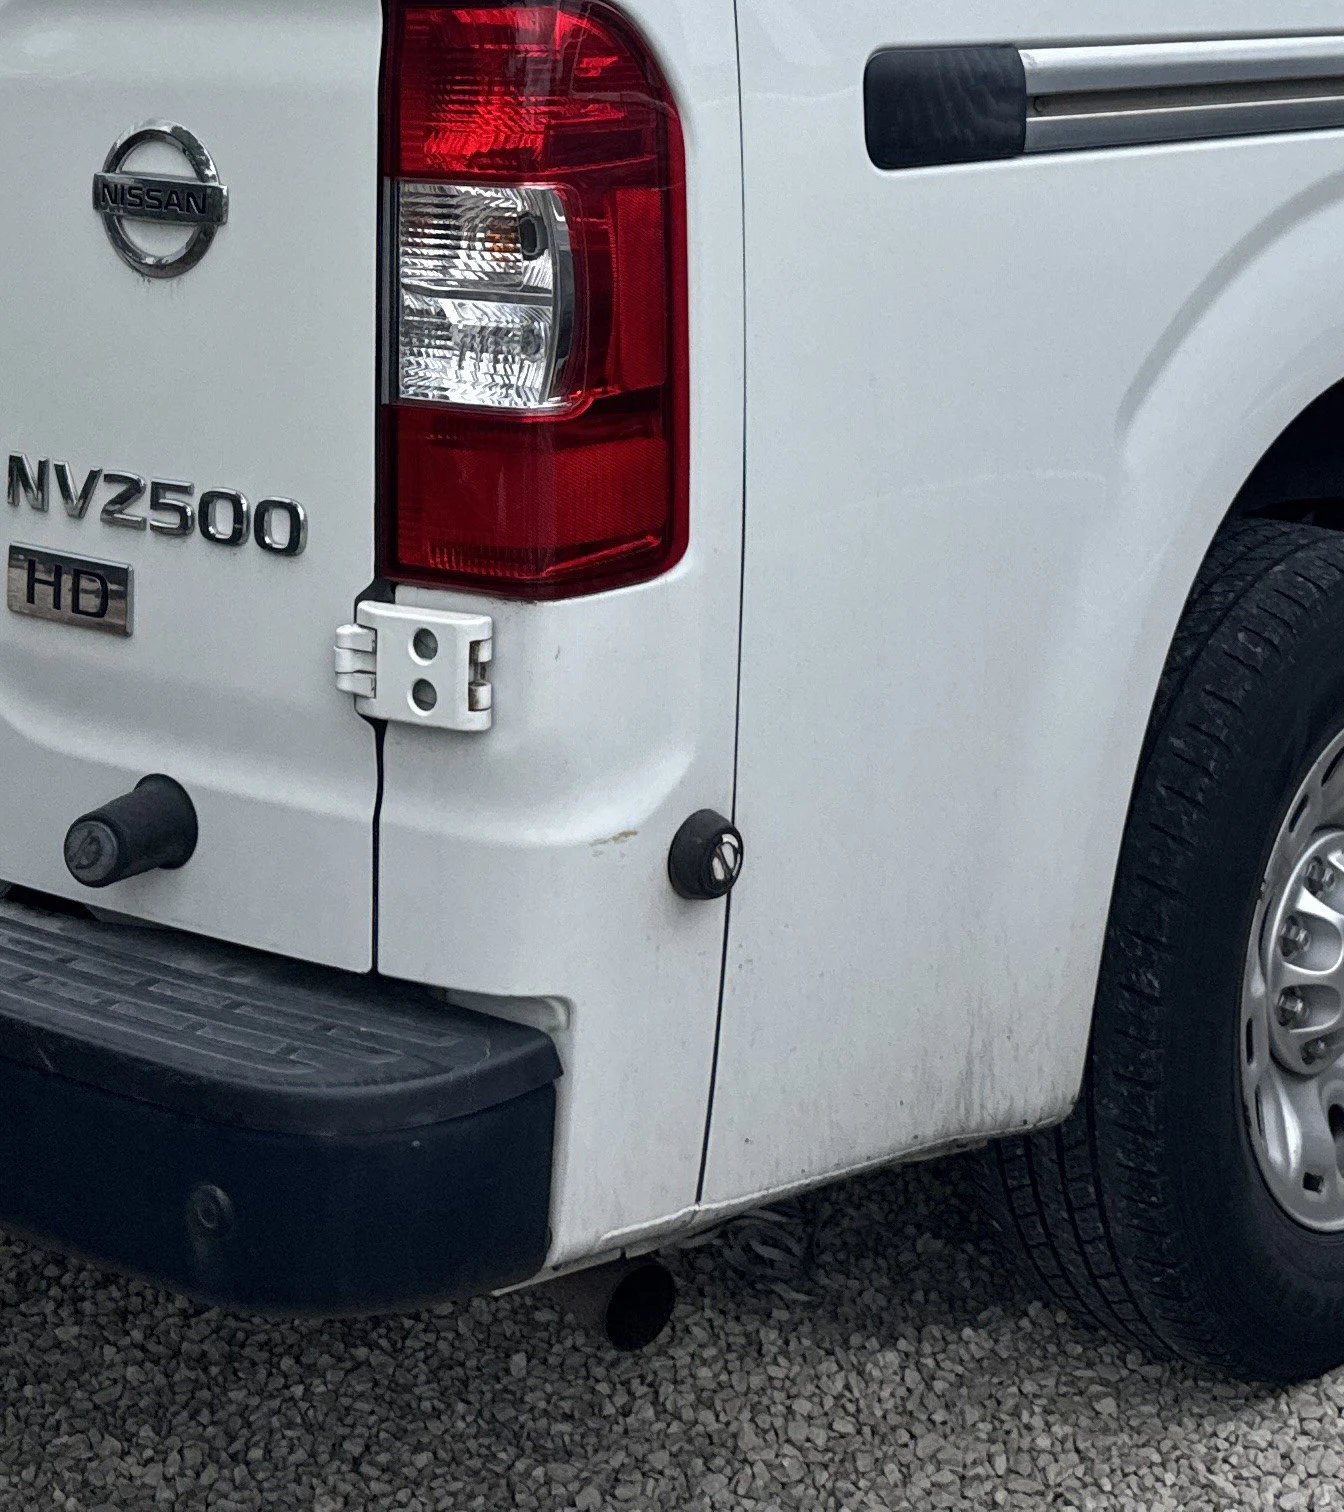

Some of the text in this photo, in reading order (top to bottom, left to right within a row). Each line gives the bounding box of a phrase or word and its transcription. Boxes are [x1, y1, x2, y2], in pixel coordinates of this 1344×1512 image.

[101, 182, 208, 216] NISSAN
[7, 450, 309, 557] NV2500
[25, 557, 110, 620] HD
